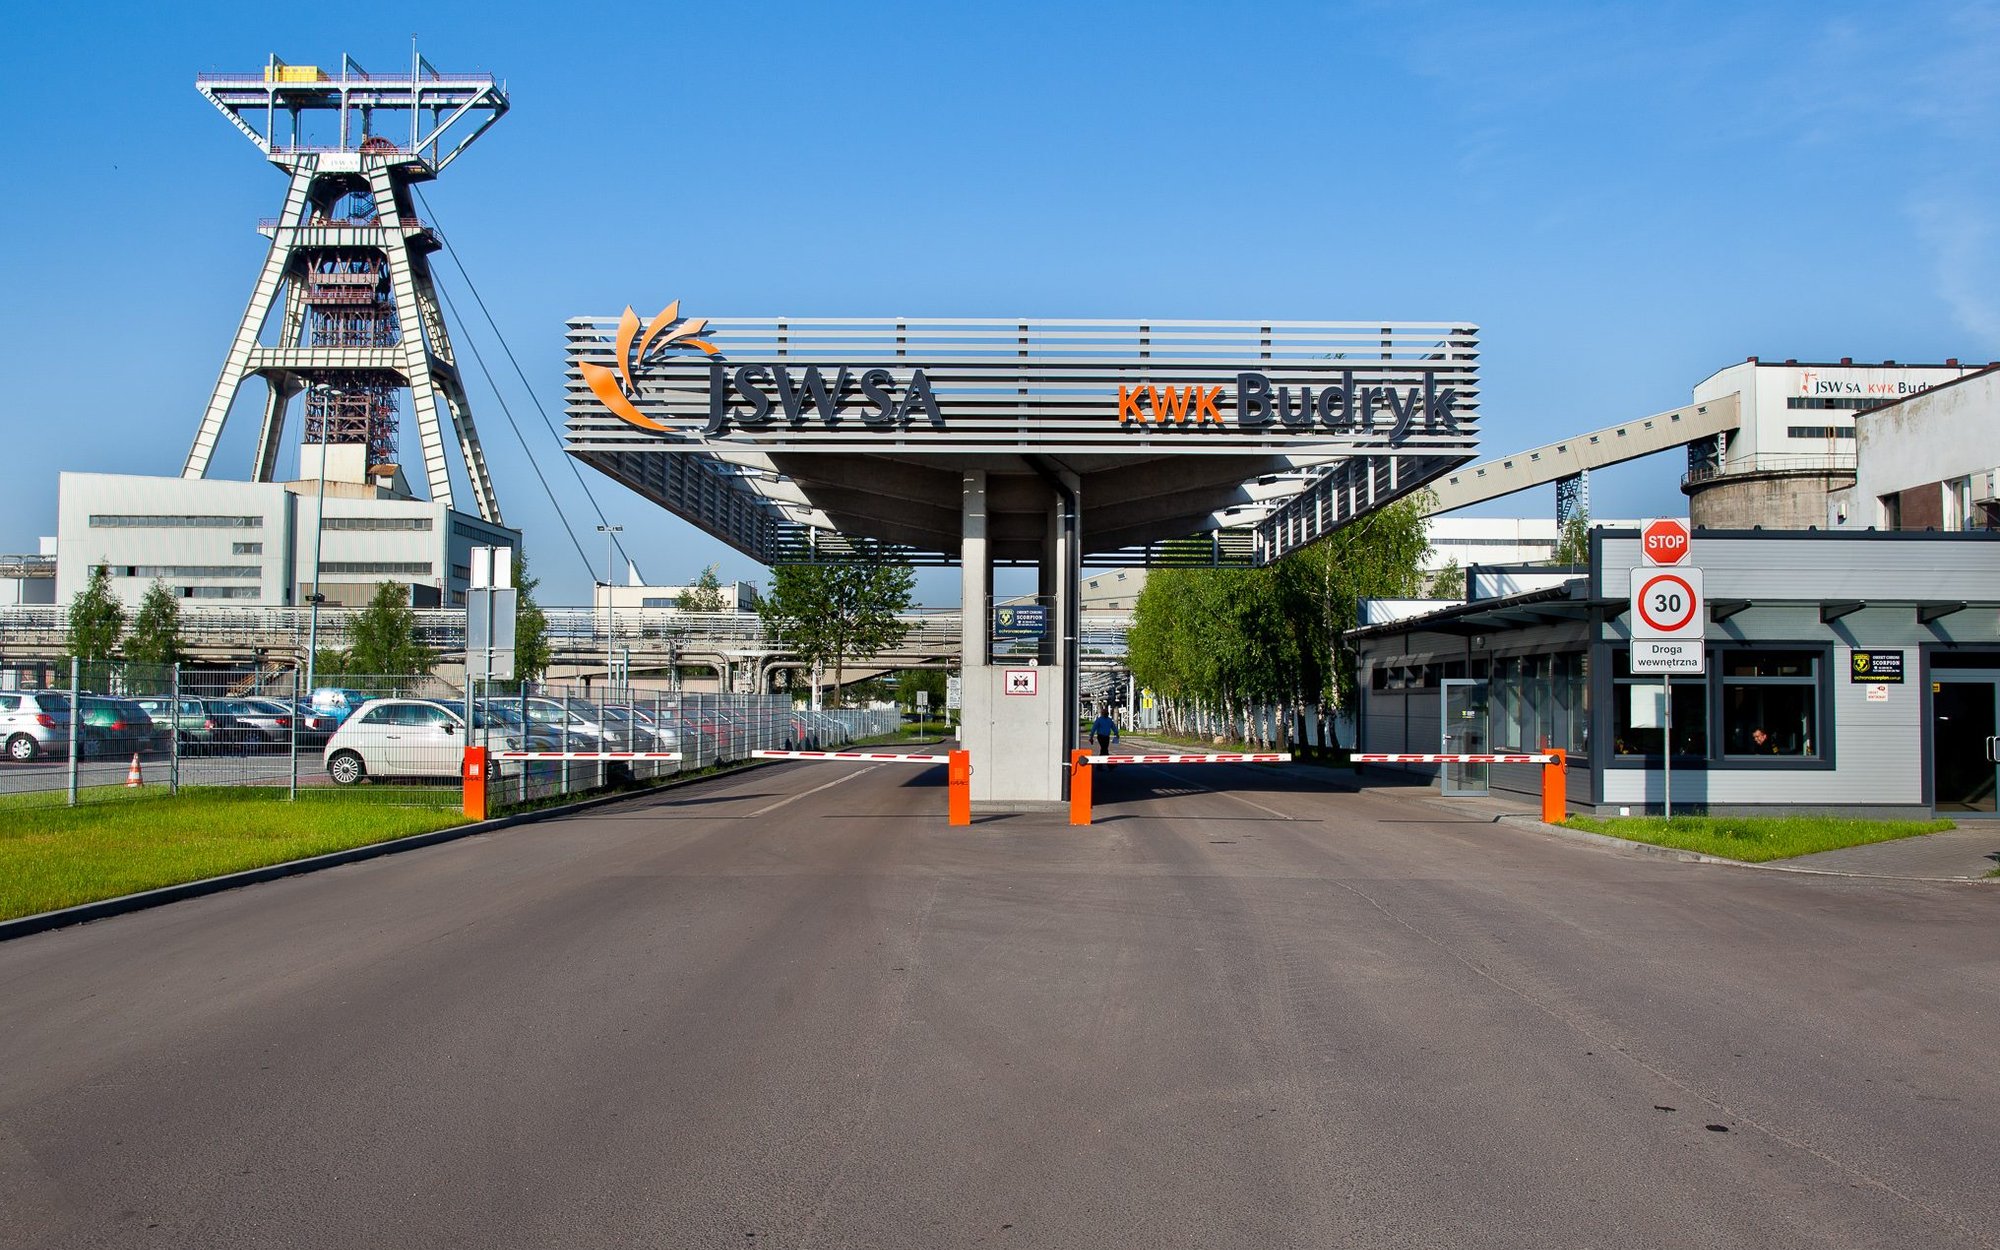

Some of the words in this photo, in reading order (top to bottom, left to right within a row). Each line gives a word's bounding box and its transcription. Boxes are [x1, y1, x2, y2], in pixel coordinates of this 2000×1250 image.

[1815, 381, 1843, 394] JSW
[1846, 383, 1861, 393] SA
[1868, 384, 1895, 393] KWK
[1117, 385, 1223, 423] KWK
[1236, 371, 1460, 449] Budryk
[1648, 535, 1685, 549] STOP
[1655, 594, 1681, 613] 30
[1652, 645, 1682, 655] Droga
[1638, 658, 1698, 669] wewnętrzna
